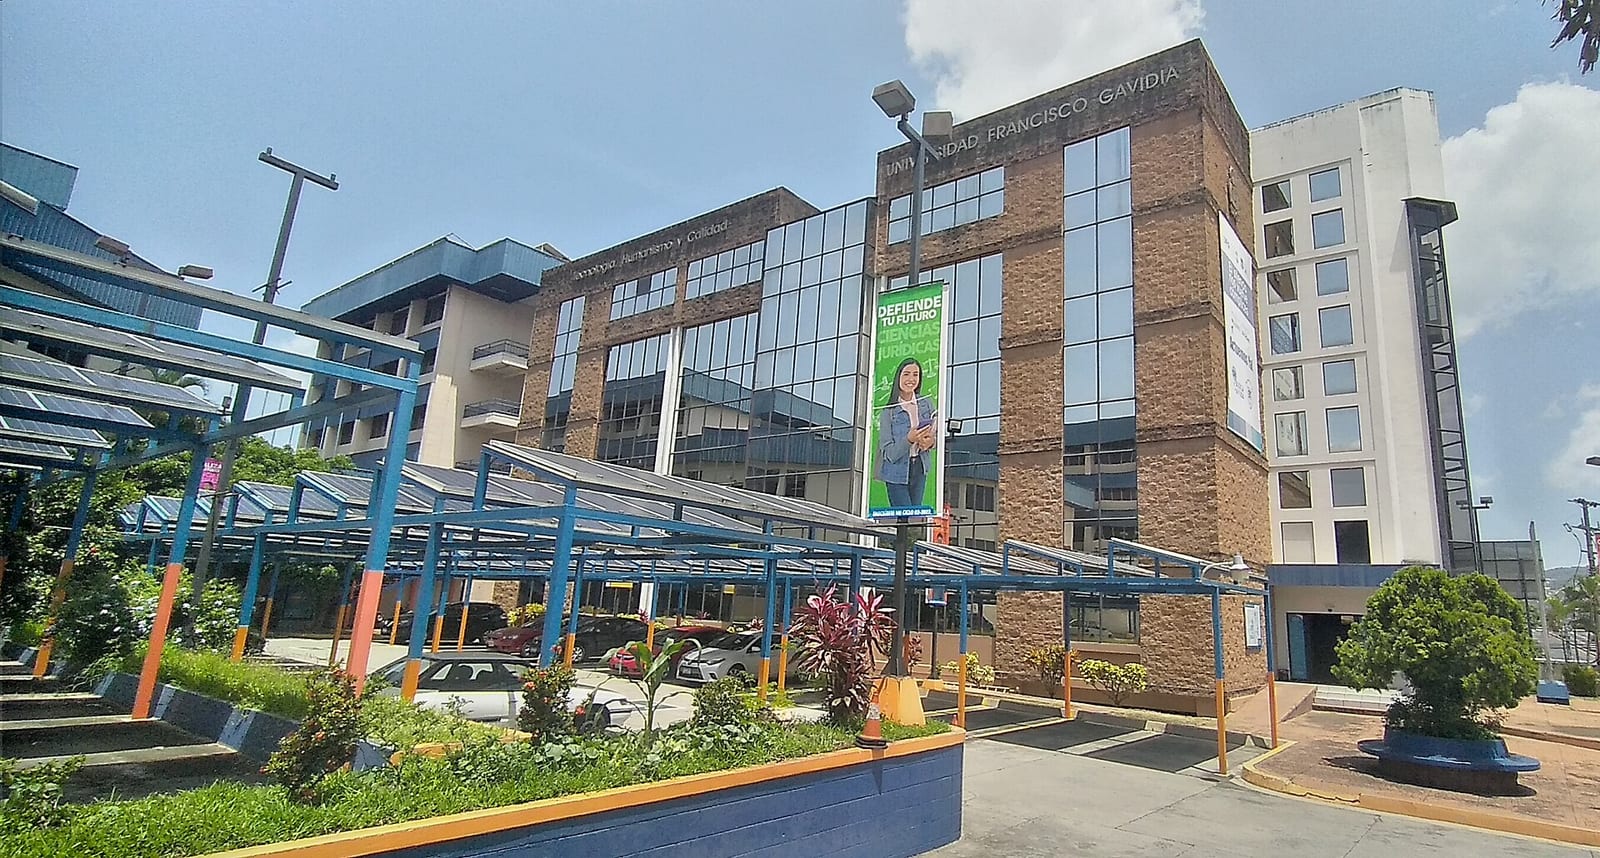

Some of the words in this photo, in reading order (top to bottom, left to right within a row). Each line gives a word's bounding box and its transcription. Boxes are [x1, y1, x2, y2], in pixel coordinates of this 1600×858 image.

[987, 97, 1087, 143] FRANCISCO
[1098, 66, 1180, 105] GAVIDIA
[686, 219, 729, 243] Calidad
[878, 295, 942, 318] DEFIENDE
[881, 316, 895, 327] TU
[896, 309, 937, 325] FUTURO
[878, 322, 940, 344] CIENCIAS
[876, 338, 940, 362] JURÍDICAS
